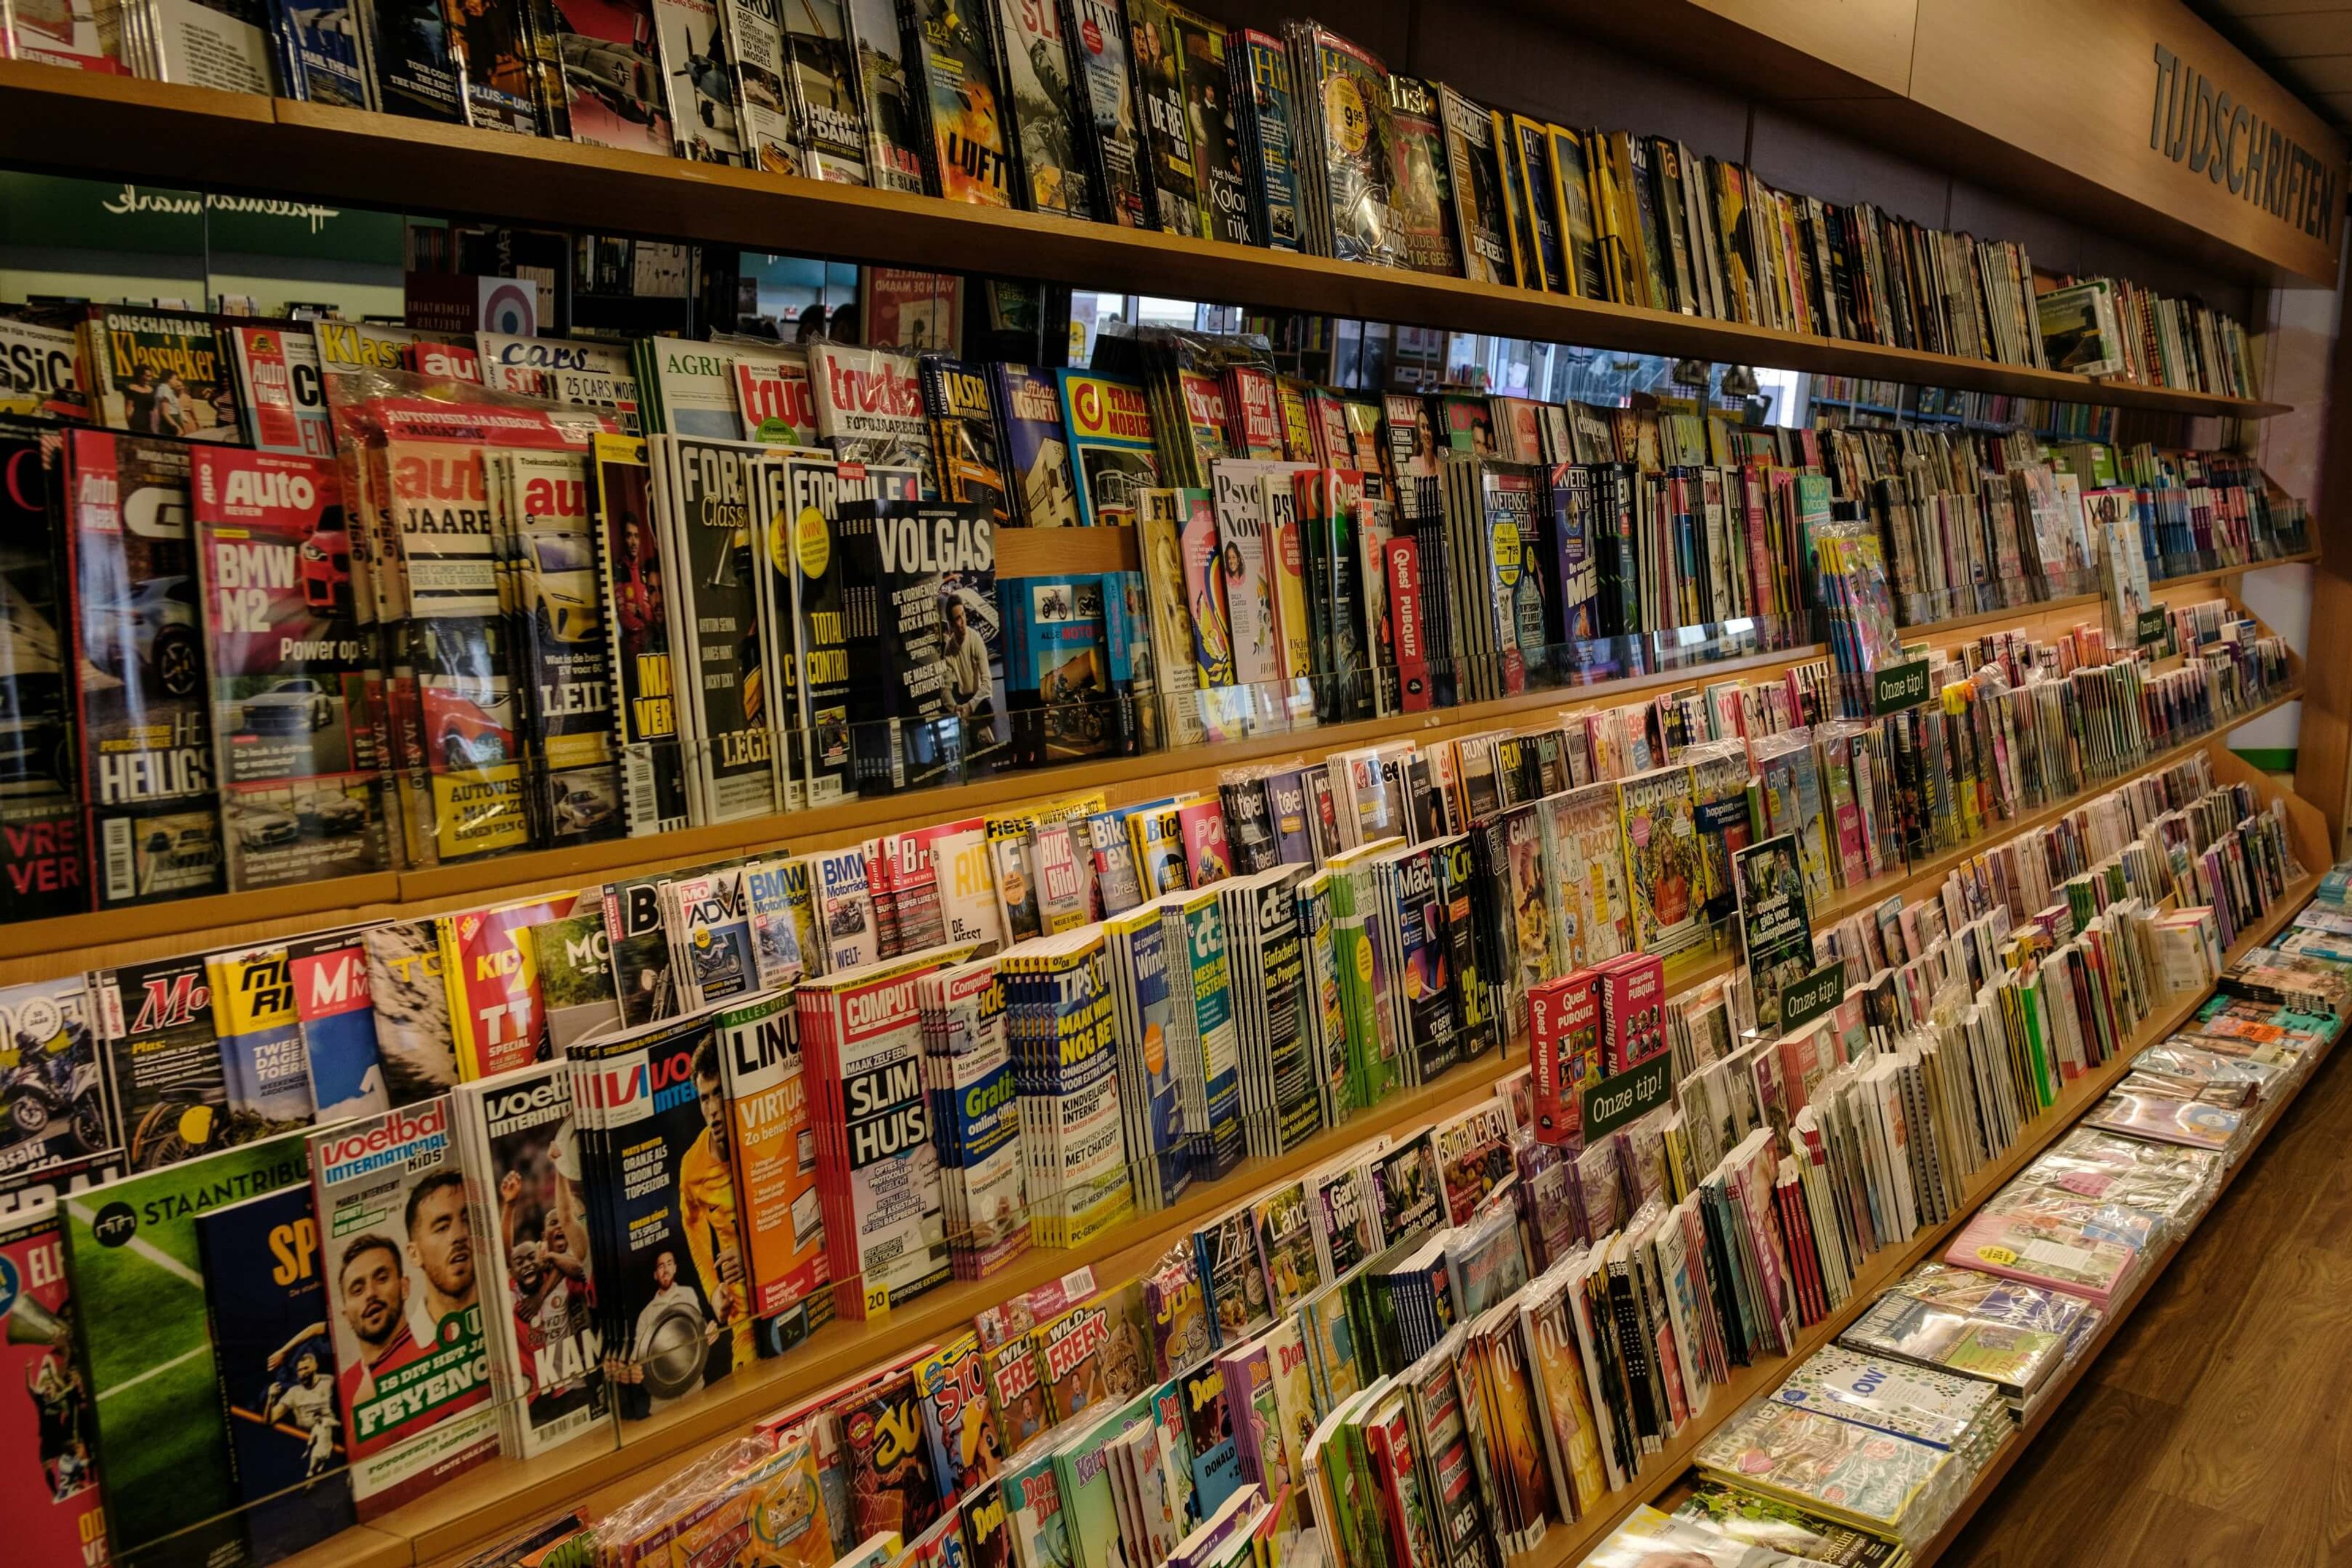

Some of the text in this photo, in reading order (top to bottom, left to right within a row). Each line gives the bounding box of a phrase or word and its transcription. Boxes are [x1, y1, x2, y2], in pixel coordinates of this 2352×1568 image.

[737, 12, 753, 25] ADD
[925, 21, 950, 40] 124
[741, 40, 752, 53] TO
[744, 49, 772, 69] MODELS
[808, 102, 860, 130] HIGH-T
[948, 132, 1006, 189] LUFT
[2150, 42, 2335, 246] TIJDSCHRIFTEN
[107, 313, 213, 337] ONSCHATBARE
[110, 330, 217, 382] Klassieker
[499, 342, 589, 370] cars
[666, 353, 723, 377] AGRI
[566, 377, 612, 399] 25 CARS
[739, 364, 816, 429] truc
[1243, 374, 1267, 407] Bild
[225, 470, 315, 510] Auto
[395, 449, 487, 501] aut
[1558, 467, 1591, 488] WETEN
[525, 477, 586, 517] au
[1216, 475, 1259, 512] Psyc
[1488, 491, 1530, 512] WETENSCH
[701, 495, 748, 529] Class
[1272, 493, 1295, 529] PSY
[876, 518, 992, 574] VOLGAS
[217, 543, 296, 589] BMW
[1392, 548, 1410, 589] Quest
[221, 587, 272, 633] M2
[892, 591, 902, 606] DE
[810, 611, 848, 645] TOTAL
[1399, 595, 1416, 657] PUBQUIZ
[280, 638, 336, 662] Power
[1880, 671, 1924, 702] Onze tip!
[451, 778, 521, 802] AUTOVIS
[1623, 774, 1692, 810] happinez
[1041, 831, 1071, 866] BIKE
[748, 864, 806, 900] BMW
[823, 852, 867, 882] BMW
[1047, 867, 1076, 898] Bild
[680, 883, 709, 902] MO
[826, 879, 870, 898] Motorräde
[1756, 894, 1790, 915] Complete
[1753, 916, 1801, 948] kamerplanten
[1760, 907, 1790, 930] gids voor
[696, 933, 709, 944] NEU
[952, 971, 992, 997] Computer
[1562, 987, 1588, 1012] Quest
[1627, 981, 1656, 1001] PUBQUIZ
[1787, 974, 1839, 1019] Onze tip!
[729, 995, 796, 1025] ALLES OVER
[845, 980, 919, 1029] COMPUT
[1058, 1004, 1094, 1038] MAAK
[1533, 999, 1548, 1036] Quest
[1558, 1004, 1594, 1030] PUBQUIZ
[1602, 978, 1616, 1048] Bicycling
[479, 998, 533, 1047] TT
[132, 1039, 167, 1055] Plus:
[253, 1038, 301, 1058] TWEE
[488, 1040, 531, 1058] SPECIAL
[734, 1009, 803, 1077] LINU
[1059, 1027, 1096, 1067] NOG
[845, 1046, 907, 1076] MAAK ZELF EEN
[1537, 1040, 1551, 1096] PUBQUIZ
[849, 1060, 920, 1117] SLIM
[965, 1069, 1017, 1118] Gratis
[1060, 1076, 1084, 1092] VOOR
[1061, 1080, 1110, 1113] KINDVEILIGER
[1593, 1066, 1663, 1125] Onze tip!
[967, 1113, 998, 1137] online
[1062, 1098, 1101, 1126] INTERNET
[323, 1101, 447, 1166] voetbal
[744, 1131, 760, 1147] Zo
[855, 1107, 927, 1164] HUIS
[1066, 1128, 1118, 1168] MET CHATGPT
[1437, 1106, 1507, 1167] BUITENLEVEN
[325, 1134, 449, 1186] INTERNATIONAL
[407, 1148, 443, 1172] KIDS
[144, 1155, 311, 1226] STAANTRIBU
[1400, 1192, 1436, 1225] Complete
[867, 1291, 886, 1311] 20
[1049, 1307, 1084, 1341] WILD
[1042, 1306, 1109, 1383] FREEK
[379, 1348, 469, 1395] IS DIT HET
